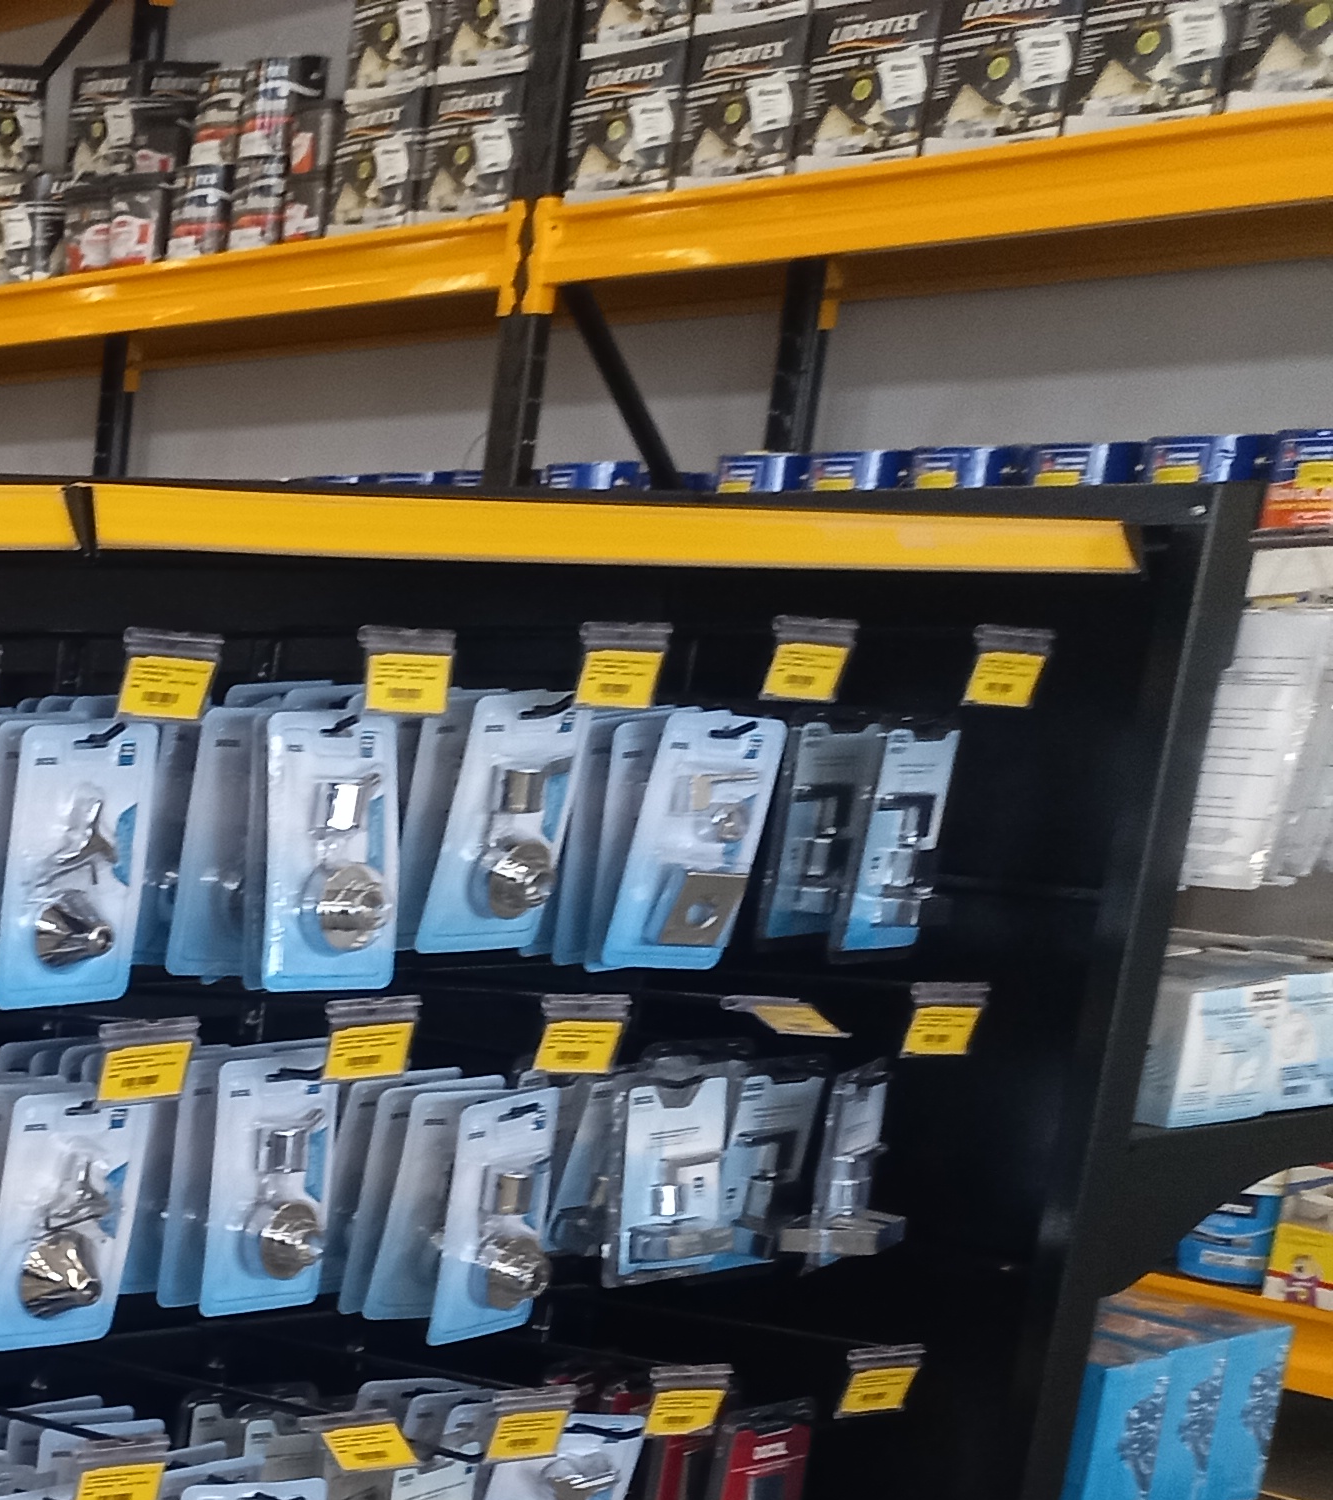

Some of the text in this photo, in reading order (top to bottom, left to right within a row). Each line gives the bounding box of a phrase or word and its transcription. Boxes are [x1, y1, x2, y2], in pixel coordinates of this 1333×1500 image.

[828, 10, 928, 46] LIDERTEX
[703, 38, 790, 72] LIDERTEX
[585, 60, 672, 90] LIDERTEX
